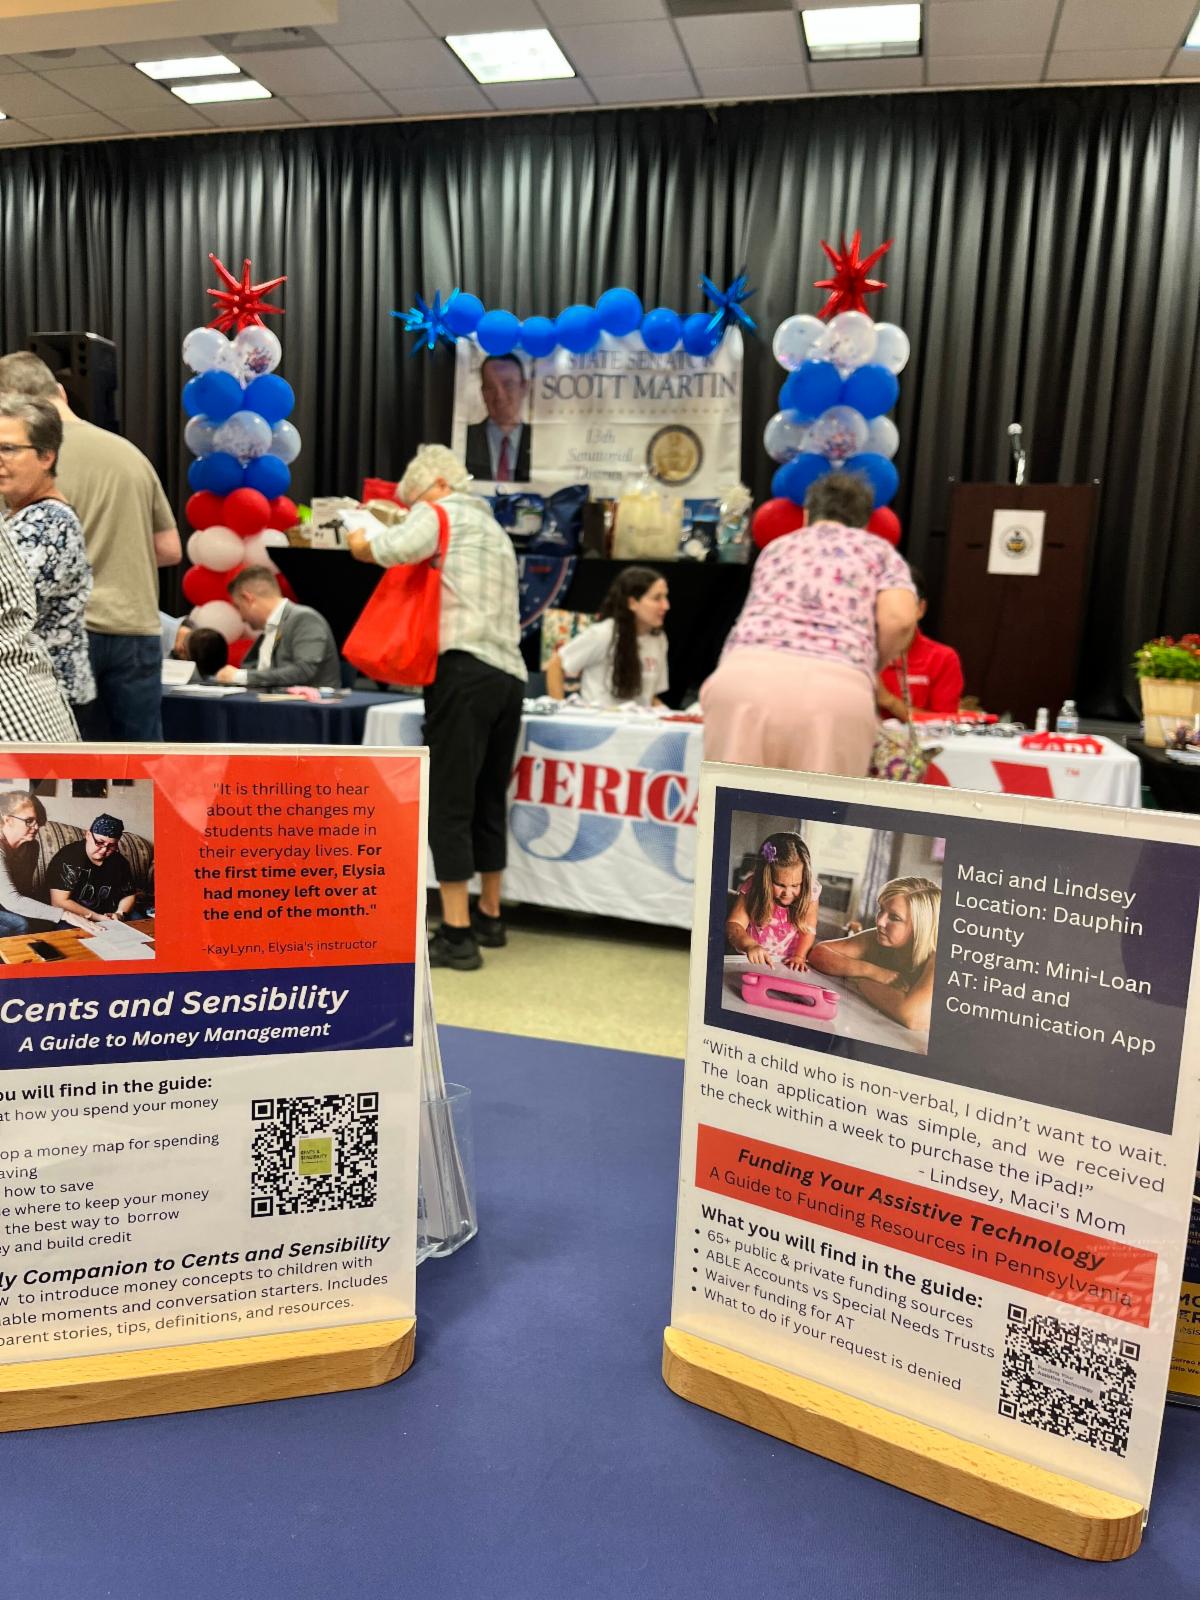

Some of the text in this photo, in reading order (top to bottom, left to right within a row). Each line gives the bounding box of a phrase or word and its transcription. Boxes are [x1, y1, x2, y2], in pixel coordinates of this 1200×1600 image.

[541, 371, 737, 400] SCOTT MARTIN
[207, 804, 375, 819] about the changes my
[236, 782, 248, 795] is
[252, 783, 312, 799] thrilling
[316, 784, 332, 795] to
[336, 783, 369, 795] hear
[512, 755, 699, 826] MERIC
[199, 844, 382, 860] their everyday lives. For
[204, 824, 376, 837] students have made in
[194, 864, 385, 879] the first time ever, Elysia
[203, 885, 377, 901] had money left over at
[958, 864, 1136, 909] Maci and Lindsey
[203, 908, 229, 920] the
[233, 906, 263, 920] end
[267, 906, 283, 919] of
[286, 906, 312, 918] the
[953, 918, 1025, 948] County
[955, 891, 1143, 936] Location: Dauphin
[268, 941, 314, 955] Elysia's
[317, 940, 377, 950] instructor
[951, 944, 1151, 995] Program: Mini-Loan
[0, 984, 349, 1024] Cents and Sensibility
[947, 970, 1070, 1008] AT: iPad and
[18, 1023, 331, 1052] A Guide to Money Management
[946, 996, 1156, 1056] Communication App
[21, 1084, 55, 1100] will
[59, 1081, 96, 1097] find
[102, 1081, 118, 1095] in
[123, 1079, 154, 1093] the
[158, 1075, 212, 1095] guide:
[747, 1053, 756, 1064] a
[761, 1055, 798, 1075] child
[804, 1066, 837, 1084] who
[842, 1072, 854, 1089] is
[860, 1081, 958, 1118] non-verbal,
[965, 1103, 970, 1117] I
[1037, 1124, 1084, 1146] want
[1092, 1135, 1112, 1152] to
[1119, 1144, 1167, 1167] wait.
[701, 1084, 724, 1100] the
[728, 1092, 772, 1113] check
[776, 1105, 823, 1127] within
[828, 1120, 837, 1131] a
[842, 1123, 884, 1144] week
[889, 1134, 906, 1149] to
[911, 1141, 993, 1173] purchase
[999, 1163, 1030, 1182] the
[702, 1060, 1165, 1193] The loan application was simple, and we received
[738, 1149, 1105, 1271] Funding Your Assistive Technology
[930, 1168, 1003, 1204] Lindsey,
[1010, 1190, 1069, 1219] Maci's
[1076, 1208, 1125, 1235] Mom
[701, 1204, 983, 1308] What you will find in the guide:
[709, 1166, 1132, 1308] A Guide to Funding Resources in Pennsylvania
[23, 1260, 148, 1285] Companion
[154, 1258, 175, 1272] to
[181, 1251, 240, 1269] Cents
[245, 1243, 285, 1262] and
[288, 1235, 391, 1258] Sensibility
[707, 1229, 973, 1328] 65+ public & private funding sources
[705, 1268, 855, 1330] Waiver funding for AT
[706, 1249, 995, 1358] ABLE Accounts vs Special Needs Trusts
[704, 1287, 961, 1391] What to do if your request is denied
